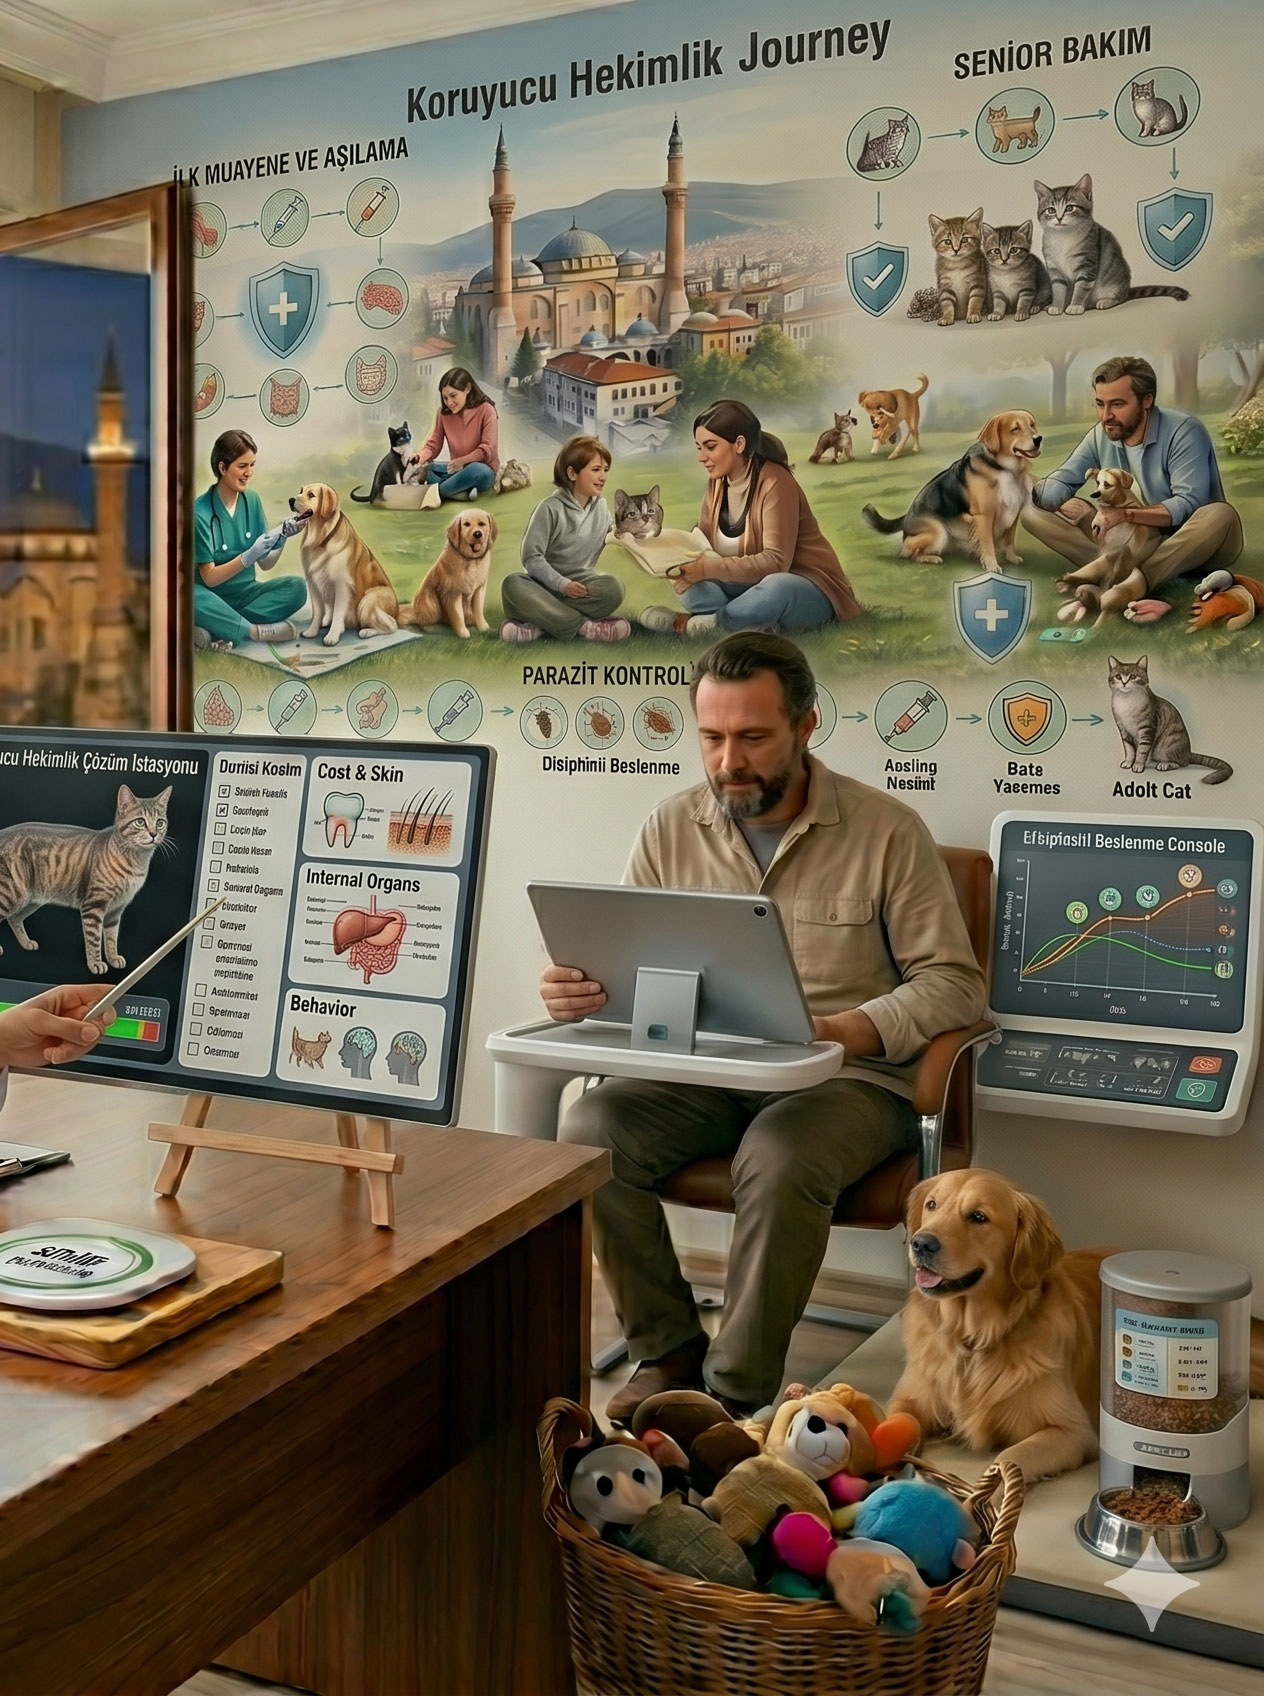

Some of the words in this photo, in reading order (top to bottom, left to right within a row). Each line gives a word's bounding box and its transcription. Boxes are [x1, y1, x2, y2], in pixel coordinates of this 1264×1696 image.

[954, 38, 1053, 81] SENİOR
[1063, 25, 1152, 66] BAKIM
[407, 72, 556, 124] Koruyucu
[570, 39, 723, 99] Hekimlik
[739, 18, 892, 73] Journey
[205, 151, 290, 186] MUAYENE
[296, 149, 319, 172] VE
[324, 136, 409, 172] AŞILAMA
[523, 661, 598, 685] PARAZİT
[604, 662, 694, 686] KONTROL
[22, 749, 79, 769] Hekimlik
[610, 757, 680, 775] Beslenme
[318, 763, 351, 780] Cost
[355, 764, 367, 781] &
[371, 765, 404, 782] Skin
[1112, 780, 1158, 798] Adolt
[1162, 782, 1192, 800] Cat
[1095, 833, 1164, 851] Beslenme
[1168, 836, 1226, 854] Console
[306, 868, 363, 888] Internal
[367, 873, 421, 894] Organs
[290, 994, 356, 1018] Behavior
